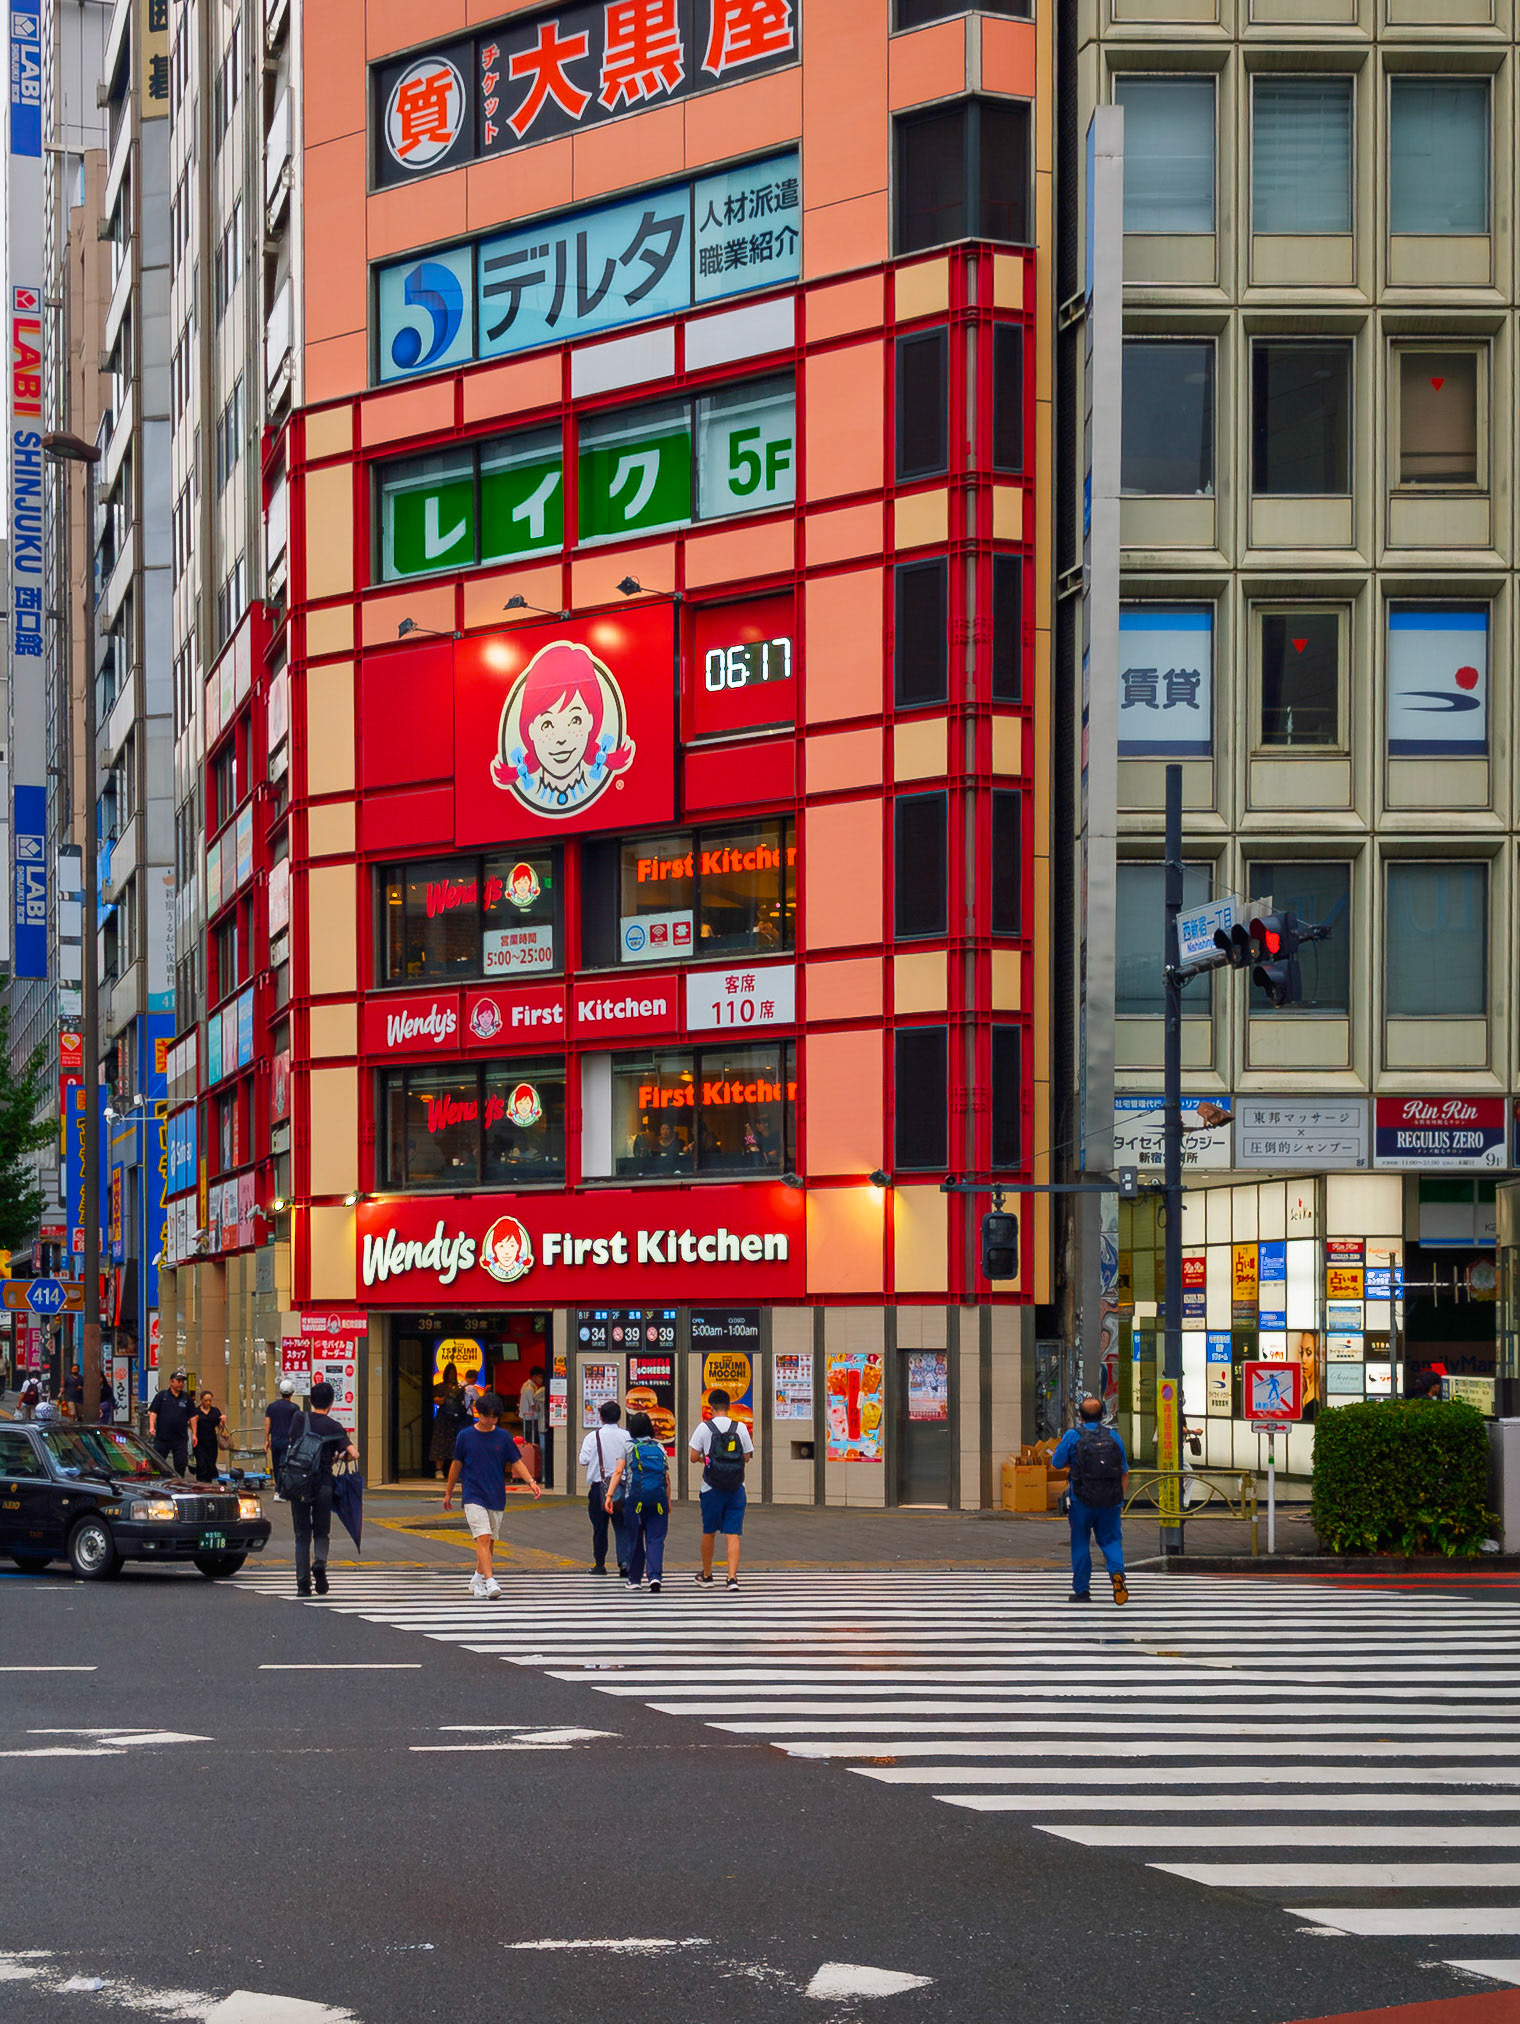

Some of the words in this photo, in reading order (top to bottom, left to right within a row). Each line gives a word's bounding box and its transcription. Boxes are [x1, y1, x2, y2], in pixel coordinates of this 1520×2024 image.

[21, 43, 40, 106] LABI
[506, 0, 794, 140] 大黒屋
[481, 42, 500, 145] チケット
[396, 66, 454, 160] 質
[698, 177, 800, 233] 人材派遣
[698, 224, 800, 278] 職業紹介
[483, 210, 686, 342] デルタ
[13, 318, 42, 418] LABI
[728, 426, 793, 497] 5F
[13, 430, 43, 574] SHINJUKU
[425, 448, 660, 560] レイク
[15, 586, 44, 657] 西口館
[704, 637, 792, 692] 06:17
[1120, 667, 1201, 710] 賃貸
[637, 851, 694, 883] First
[26, 865, 46, 926] LABI
[724, 973, 756, 995] 客席
[386, 1004, 457, 1047] Wendy's
[511, 1002, 564, 1028] First
[577, 998, 667, 1023] Kitchen
[638, 1083, 695, 1109] First
[1253, 1111, 1350, 1125] 東邦マッサージ
[1402, 1100, 1440, 1119] Rin
[1441, 1100, 1479, 1119] Rin
[1250, 1141, 1353, 1154] 圧倒的シャンプー
[1396, 1131, 1451, 1149] REGULUS
[1452, 1131, 1485, 1149] ZERO
[1485, 1152, 1503, 1167] 9F
[363, 1220, 476, 1286] Wendy's
[542, 1231, 629, 1267] First
[637, 1227, 790, 1264] Kitchen
[33, 1287, 60, 1305] 414
[611, 1311, 620, 1320] 2F
[645, 1311, 654, 1320] 3F
[591, 1327, 606, 1341] 34
[624, 1327, 640, 1341] 39
[659, 1327, 674, 1341] 39
[692, 1325, 722, 1337] 5:00am
[728, 1325, 758, 1337] 1:00am
[286, 1350, 307, 1359] スタッフ
[321, 1340, 346, 1349] モバイル
[321, 1349, 346, 1358] オーダー
[708, 1361, 746, 1370] TSUKIMI
[708, 1369, 746, 1378] MOCCHI
